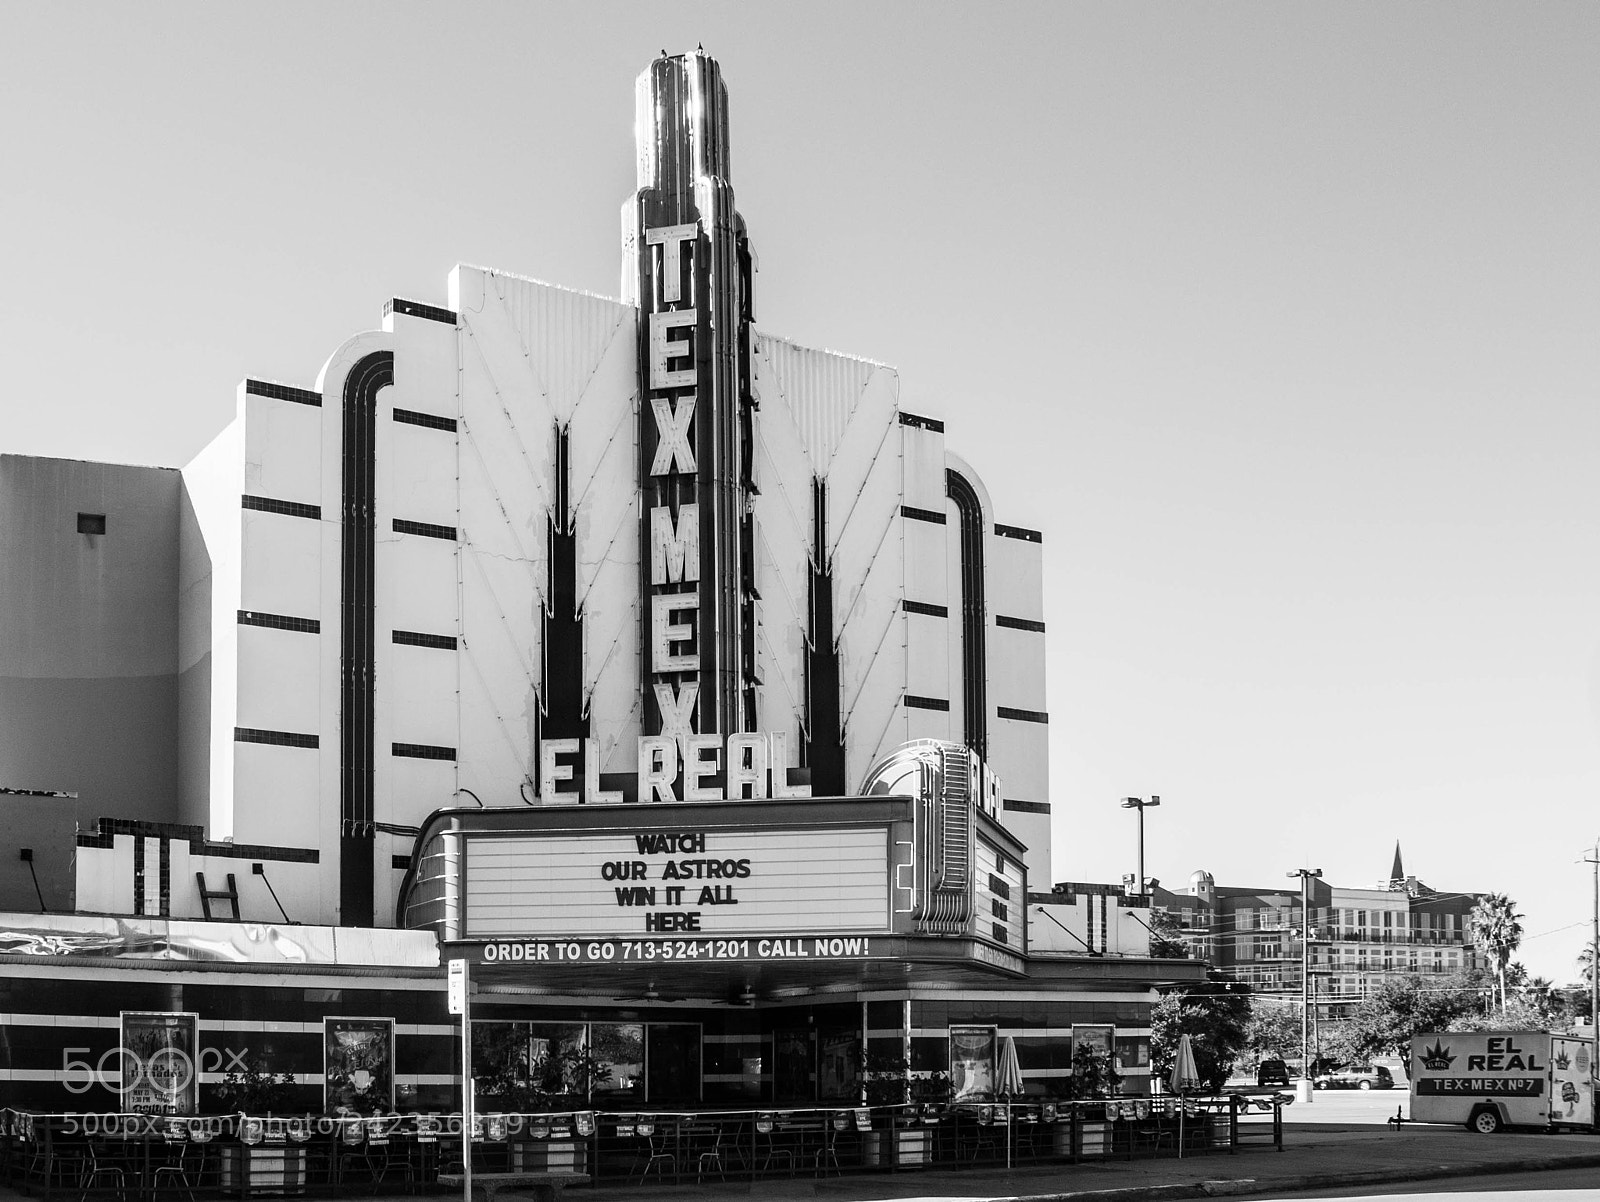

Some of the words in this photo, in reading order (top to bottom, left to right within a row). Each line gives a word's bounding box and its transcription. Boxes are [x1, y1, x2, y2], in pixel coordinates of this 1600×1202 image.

[646, 224, 698, 476] TEX
[540, 737, 625, 804] EL
[637, 731, 813, 802] REAL
[635, 833, 706, 856] WATCH
[601, 862, 647, 881] OUR
[662, 859, 751, 880] ASTROS
[615, 887, 656, 907] WIN
[665, 886, 684, 906] IT
[697, 885, 738, 905] ALL
[646, 913, 701, 933] HERE
[483, 944, 550, 961] ORDER
[555, 944, 582, 961] TO
[587, 943, 616, 961] GO
[621, 941, 751, 960] 713-524-1201
[757, 940, 808, 958] CALL
[814, 938, 870, 957] NOW!
[1487, 1037, 1522, 1054] EL
[1467, 1055, 1544, 1071] REAL
[1433, 1079, 1505, 1091] TEX-MEX
